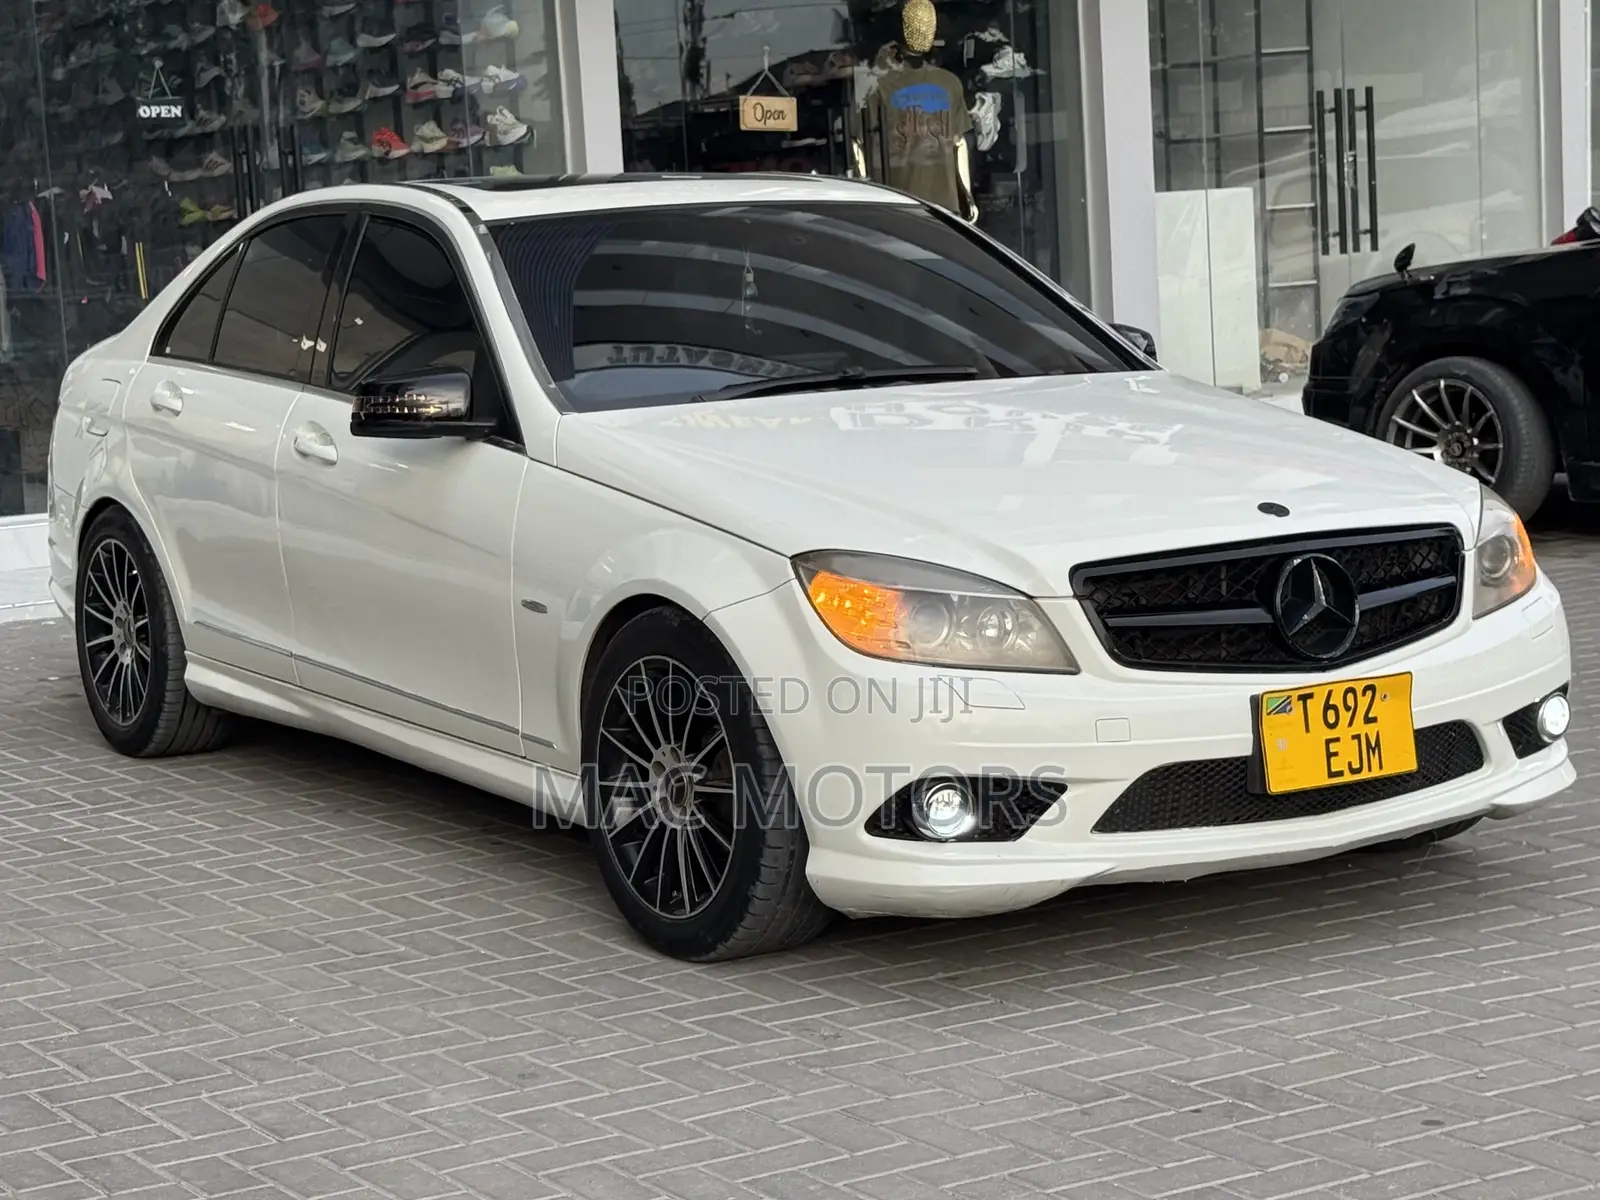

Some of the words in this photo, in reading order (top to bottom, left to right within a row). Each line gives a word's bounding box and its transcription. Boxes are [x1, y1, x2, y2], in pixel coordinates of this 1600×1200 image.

[138, 104, 183, 119] OPEN
[752, 101, 788, 127] Open
[1296, 691, 1315, 734] T
[1322, 683, 1378, 730] 692
[1324, 729, 1384, 779] EJM
